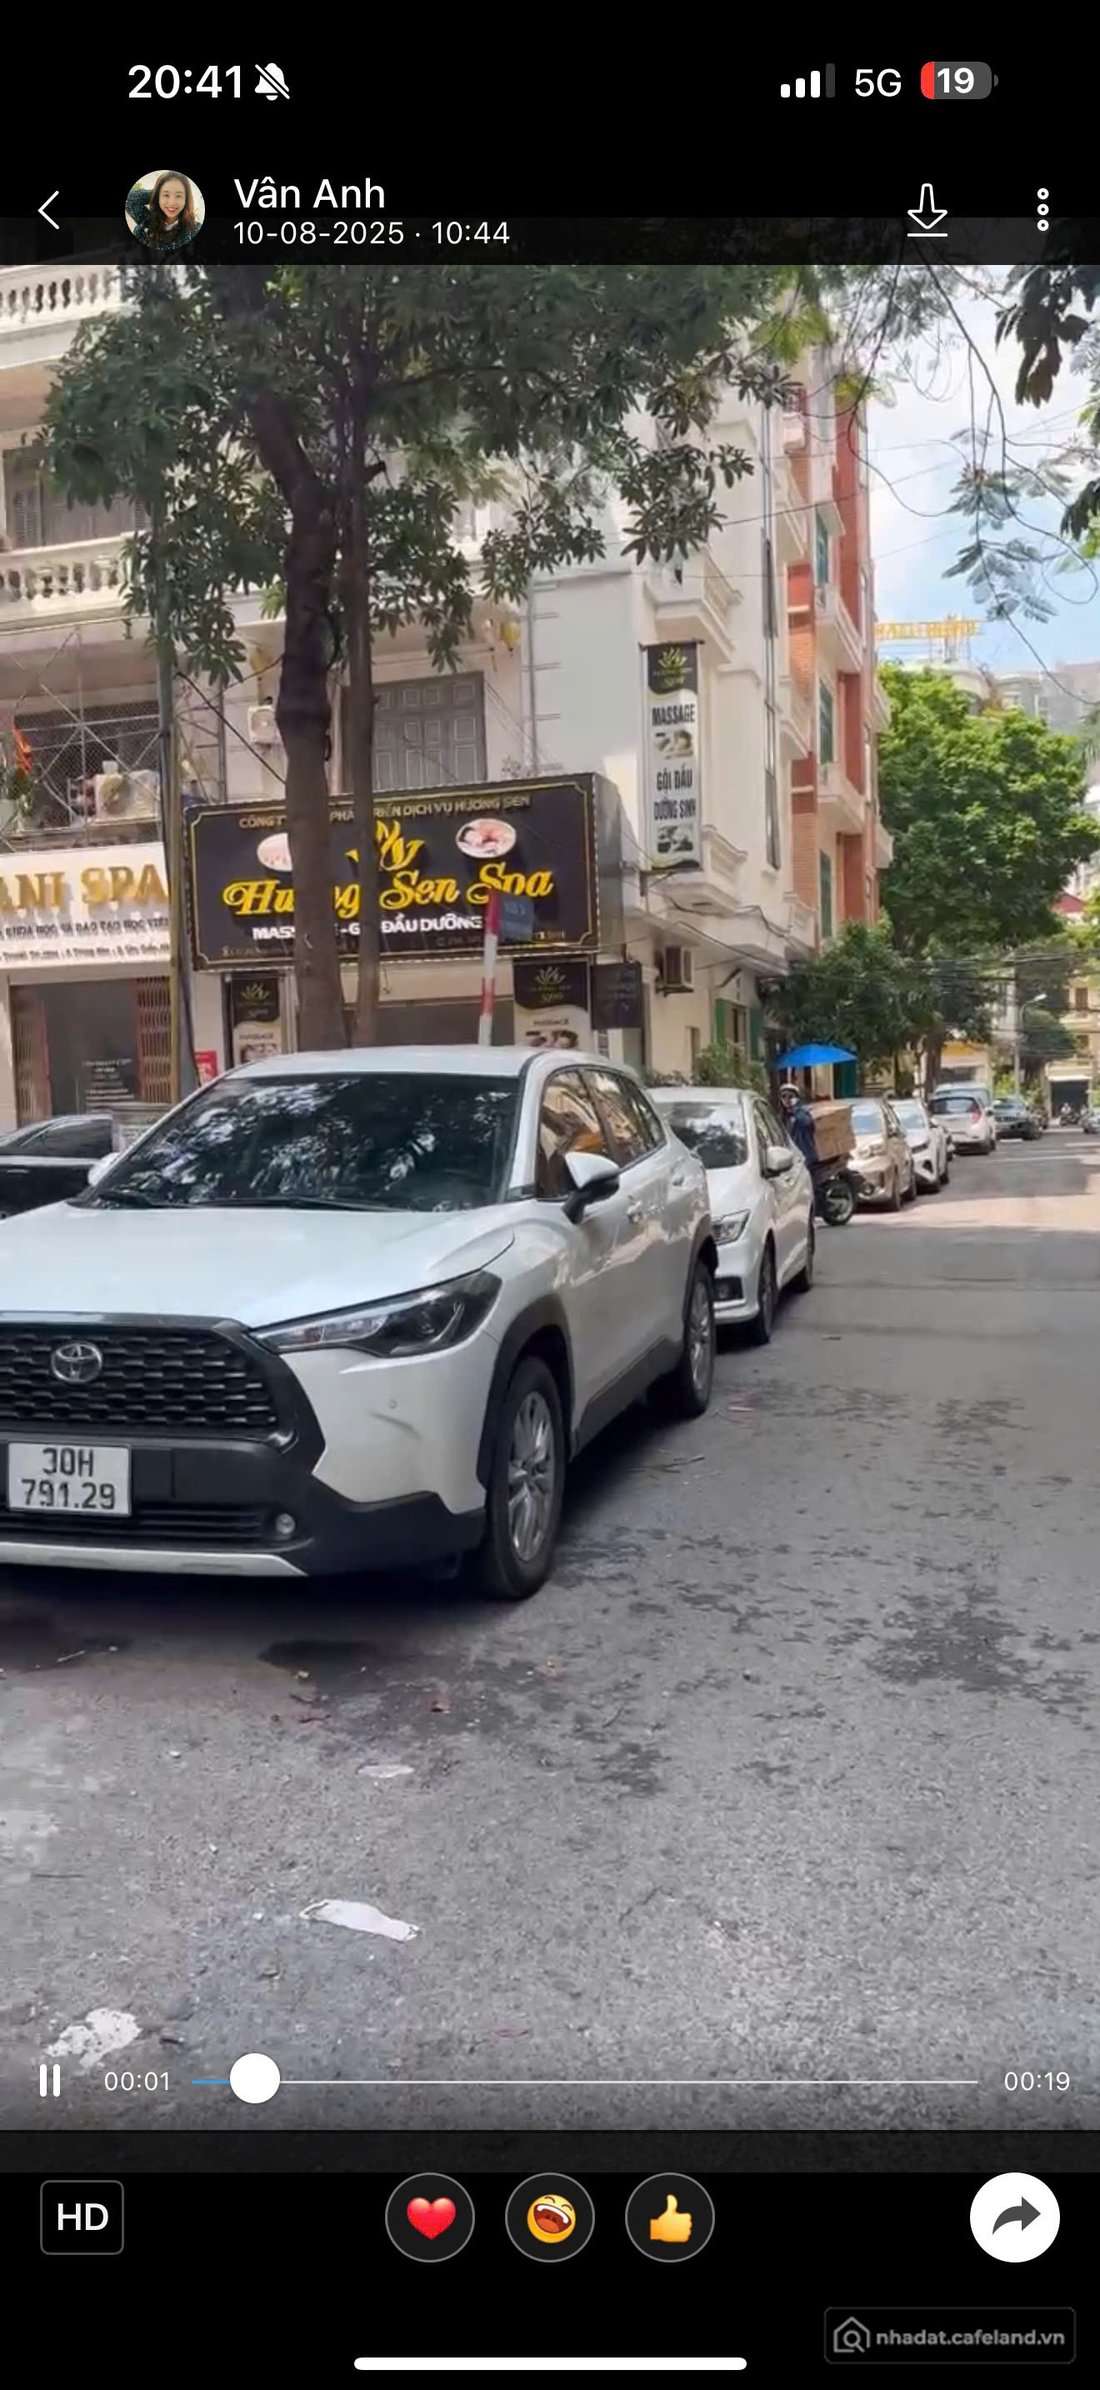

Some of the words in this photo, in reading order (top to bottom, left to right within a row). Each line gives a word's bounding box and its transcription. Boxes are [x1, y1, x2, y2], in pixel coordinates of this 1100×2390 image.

[652, 704, 695, 726] MASSAGE
[81, 864, 169, 904] SPA
[379, 870, 461, 910] Sen
[466, 861, 555, 905] Spa
[42, 1447, 94, 1477] 30H
[21, 1478, 116, 1510] 791.29
